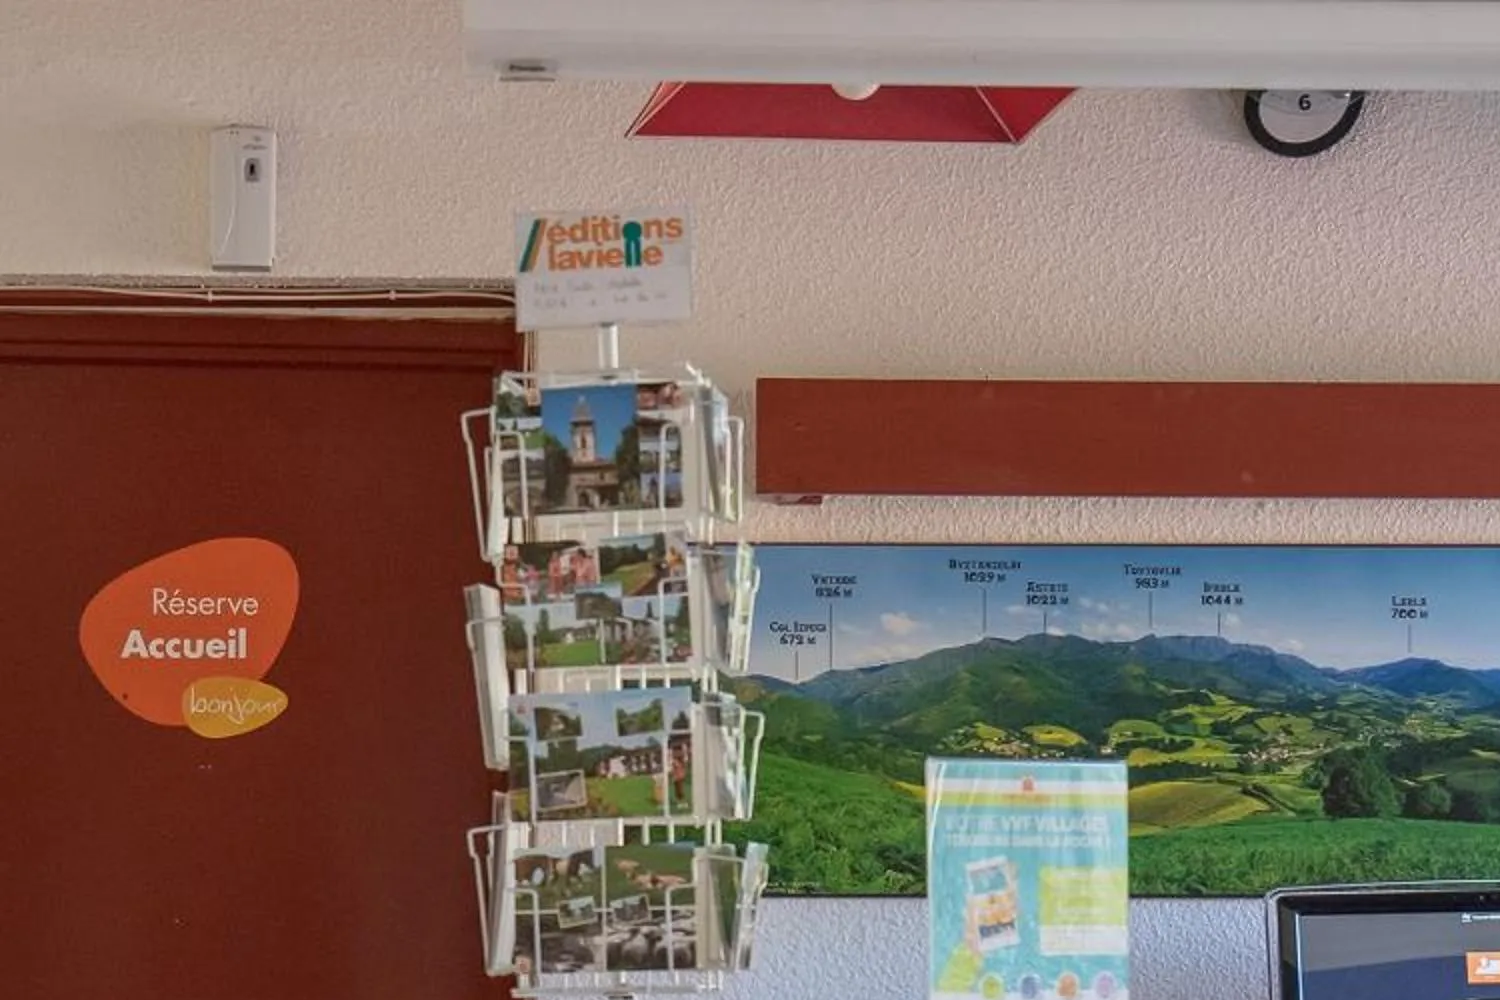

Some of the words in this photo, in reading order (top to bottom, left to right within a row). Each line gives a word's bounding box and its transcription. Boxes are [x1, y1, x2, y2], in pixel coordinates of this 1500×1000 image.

[1298, 93, 1312, 112] 6
[548, 240, 664, 271] lavielle
[152, 587, 259, 616] Réserve
[120, 627, 248, 660] Accueil
[189, 686, 280, 725] bonjour
